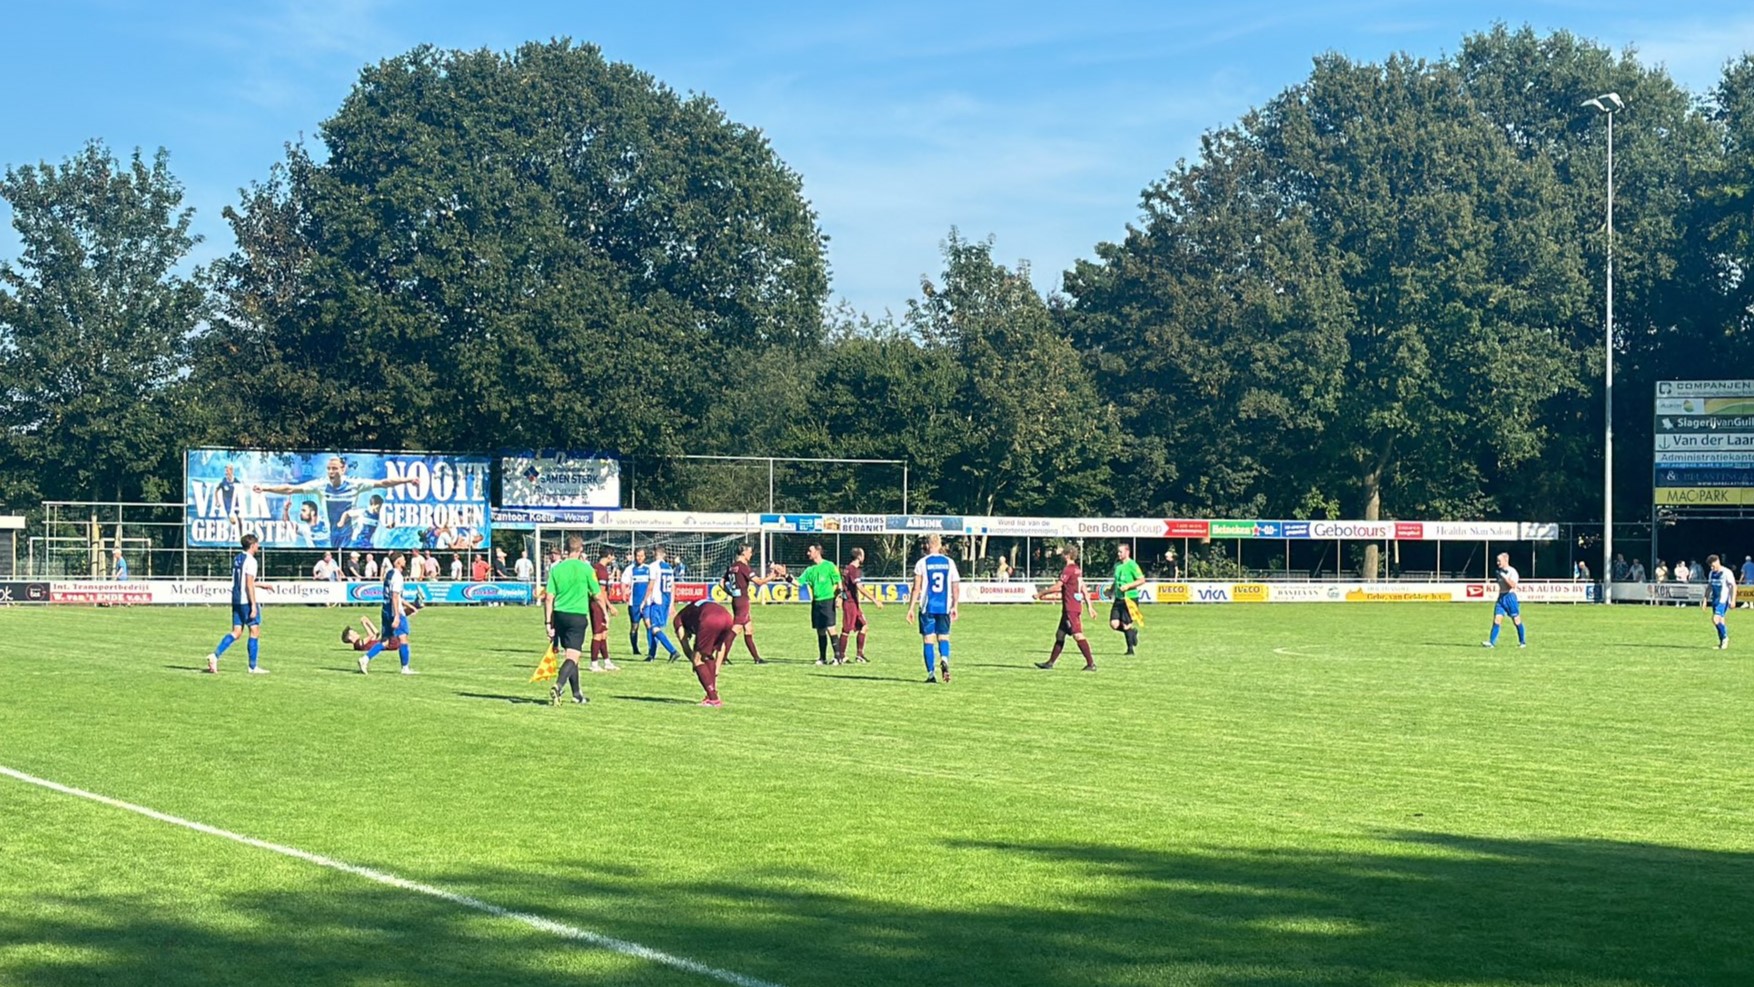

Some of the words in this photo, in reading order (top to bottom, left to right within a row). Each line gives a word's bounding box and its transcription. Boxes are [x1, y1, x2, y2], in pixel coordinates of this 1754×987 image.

[1673, 435, 1697, 446] Van
[1701, 434, 1723, 446] der
[385, 461, 490, 501] NOOIT
[540, 474, 570, 484] SAMEN
[572, 474, 599, 484] STERK
[191, 480, 272, 518] VAAK
[380, 504, 486, 528] GEBROKEN
[563, 513, 590, 523] Wezep
[842, 516, 884, 524] SPONSORS
[191, 519, 299, 543] GEBARSTEN
[842, 524, 884, 532] BEDANKT
[1078, 522, 1099, 533] Den
[1101, 522, 1129, 533] Boon
[1130, 522, 1163, 535] Group
[1314, 523, 1387, 537] Gebotours
[931, 572, 945, 593] 3
[1158, 585, 1185, 593] IVECO
[1234, 585, 1261, 593] IVECO
[1486, 585, 1534, 593] KLSEN
[711, 583, 799, 601] GRAGE
